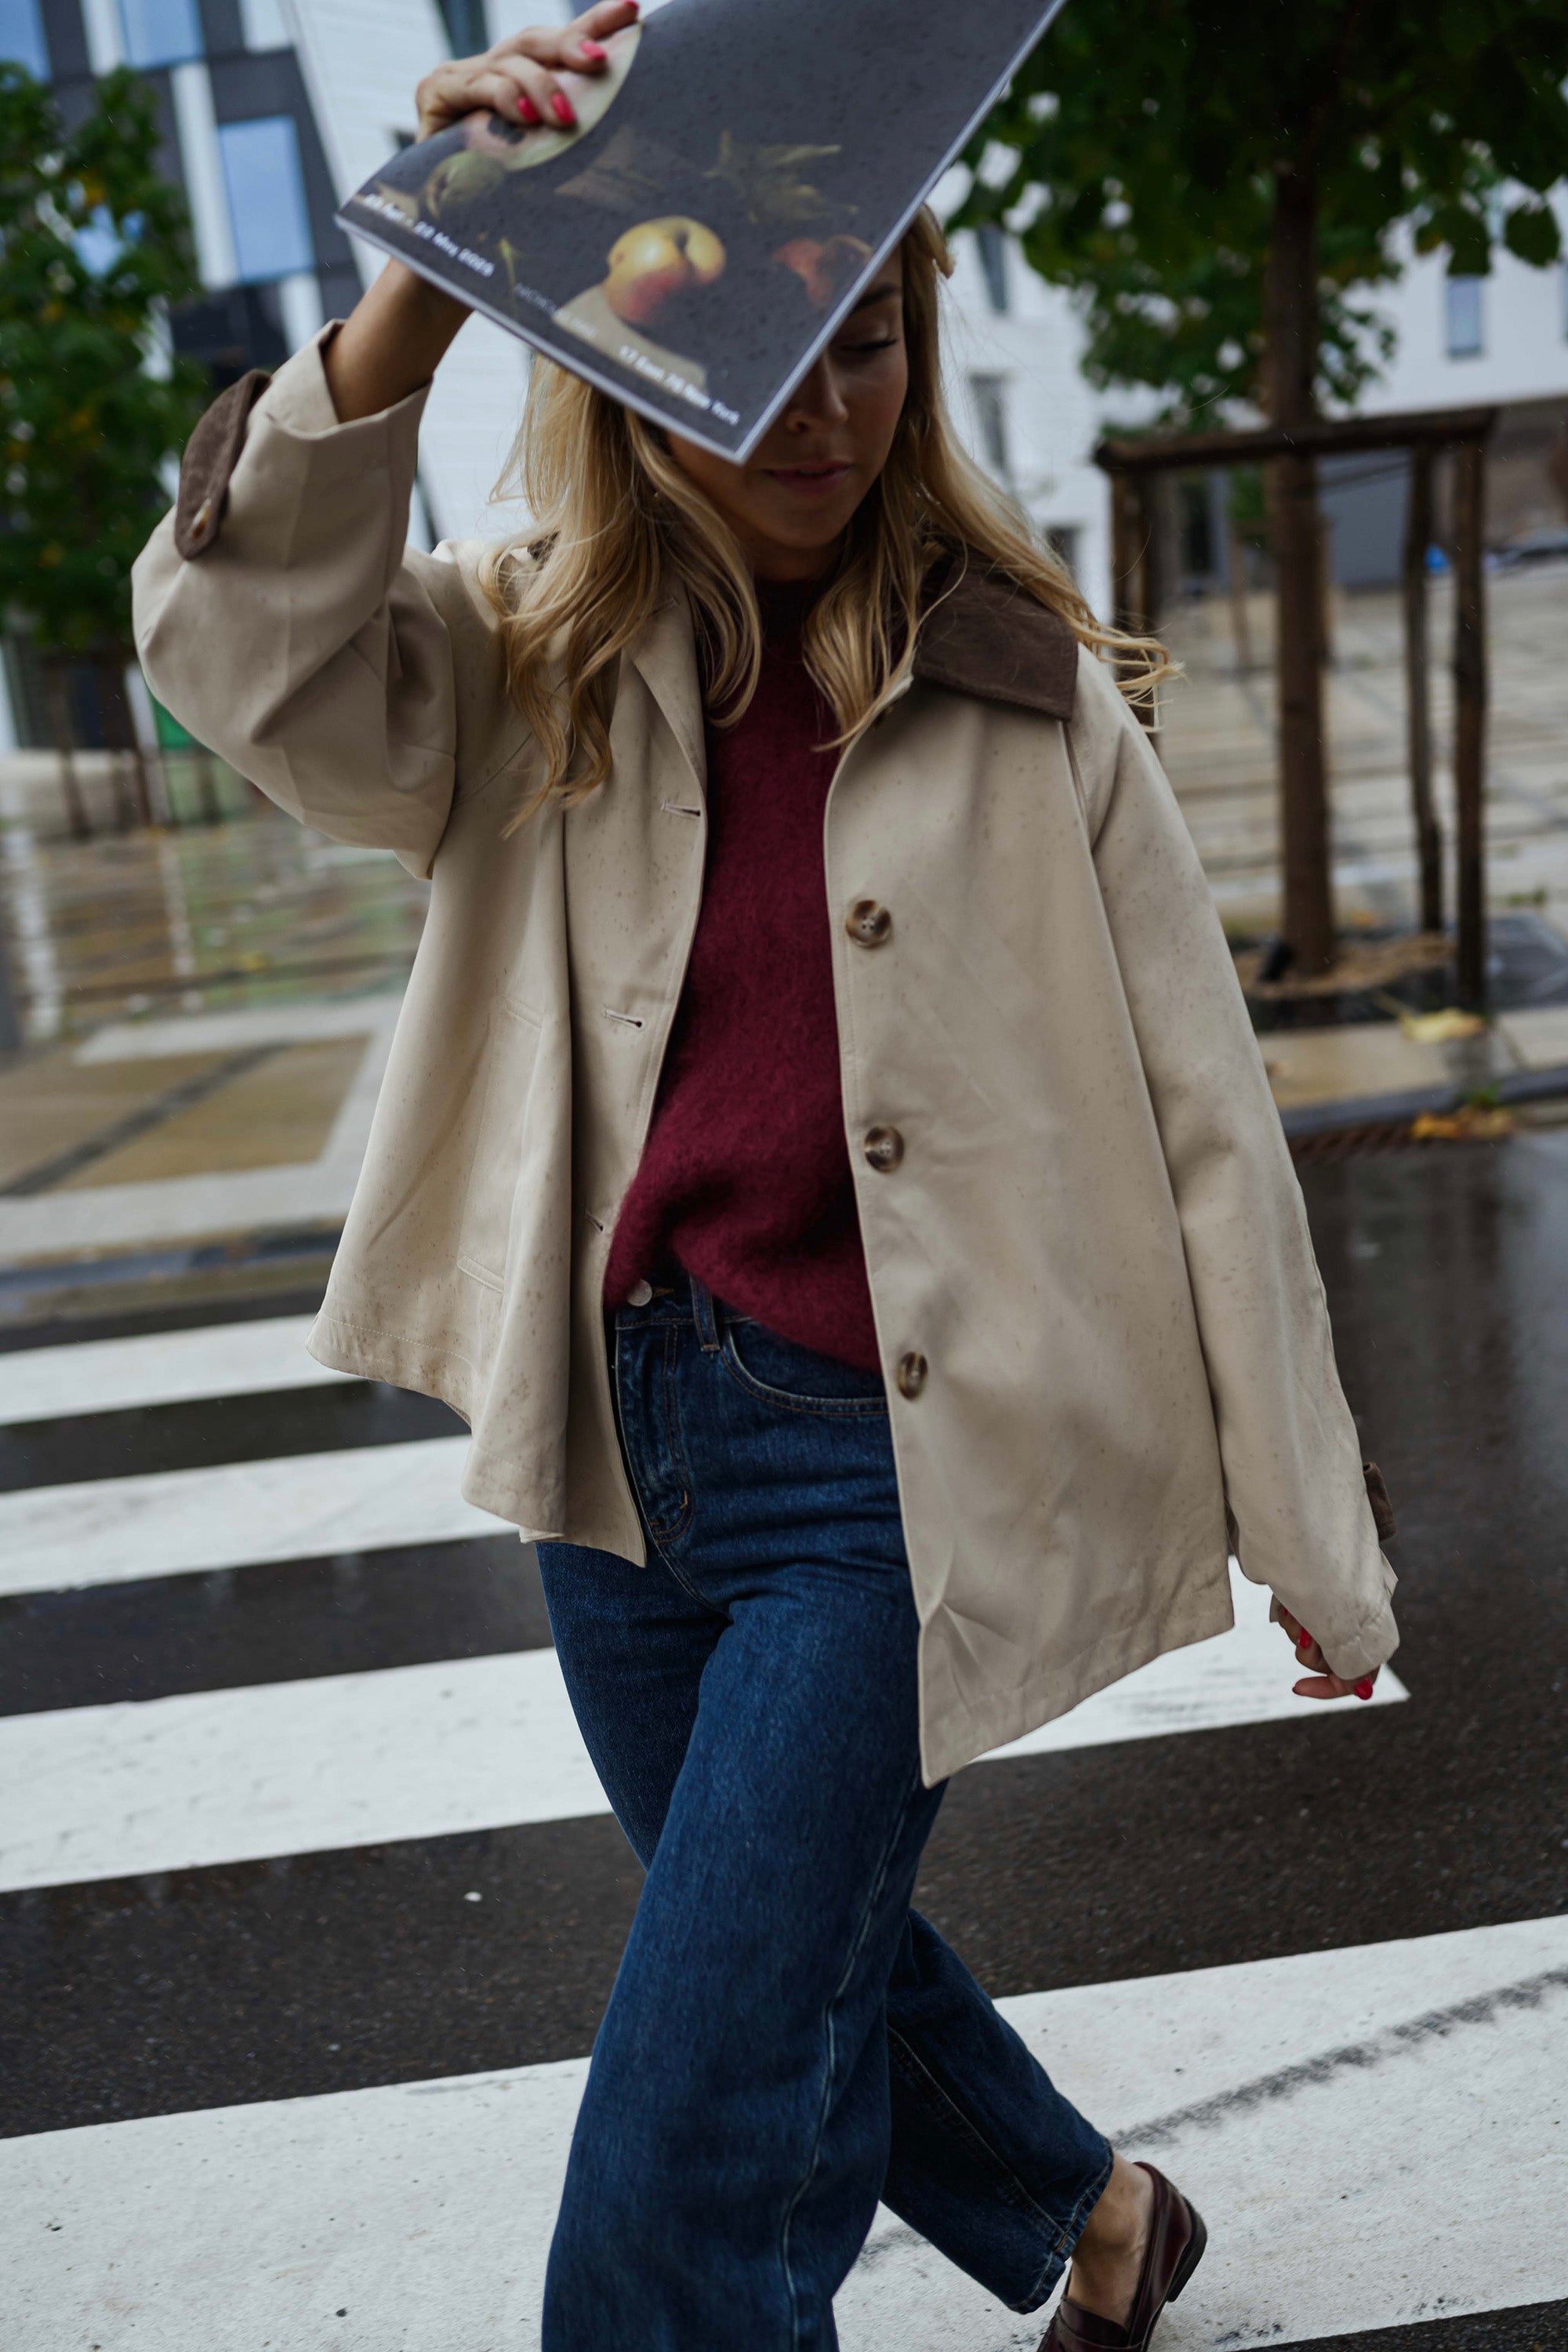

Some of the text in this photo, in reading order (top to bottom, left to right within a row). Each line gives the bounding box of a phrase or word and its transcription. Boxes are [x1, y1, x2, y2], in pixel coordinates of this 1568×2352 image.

[432, 232, 460, 259] May
[683, 383, 711, 410] New
[710, 401, 741, 426] York
